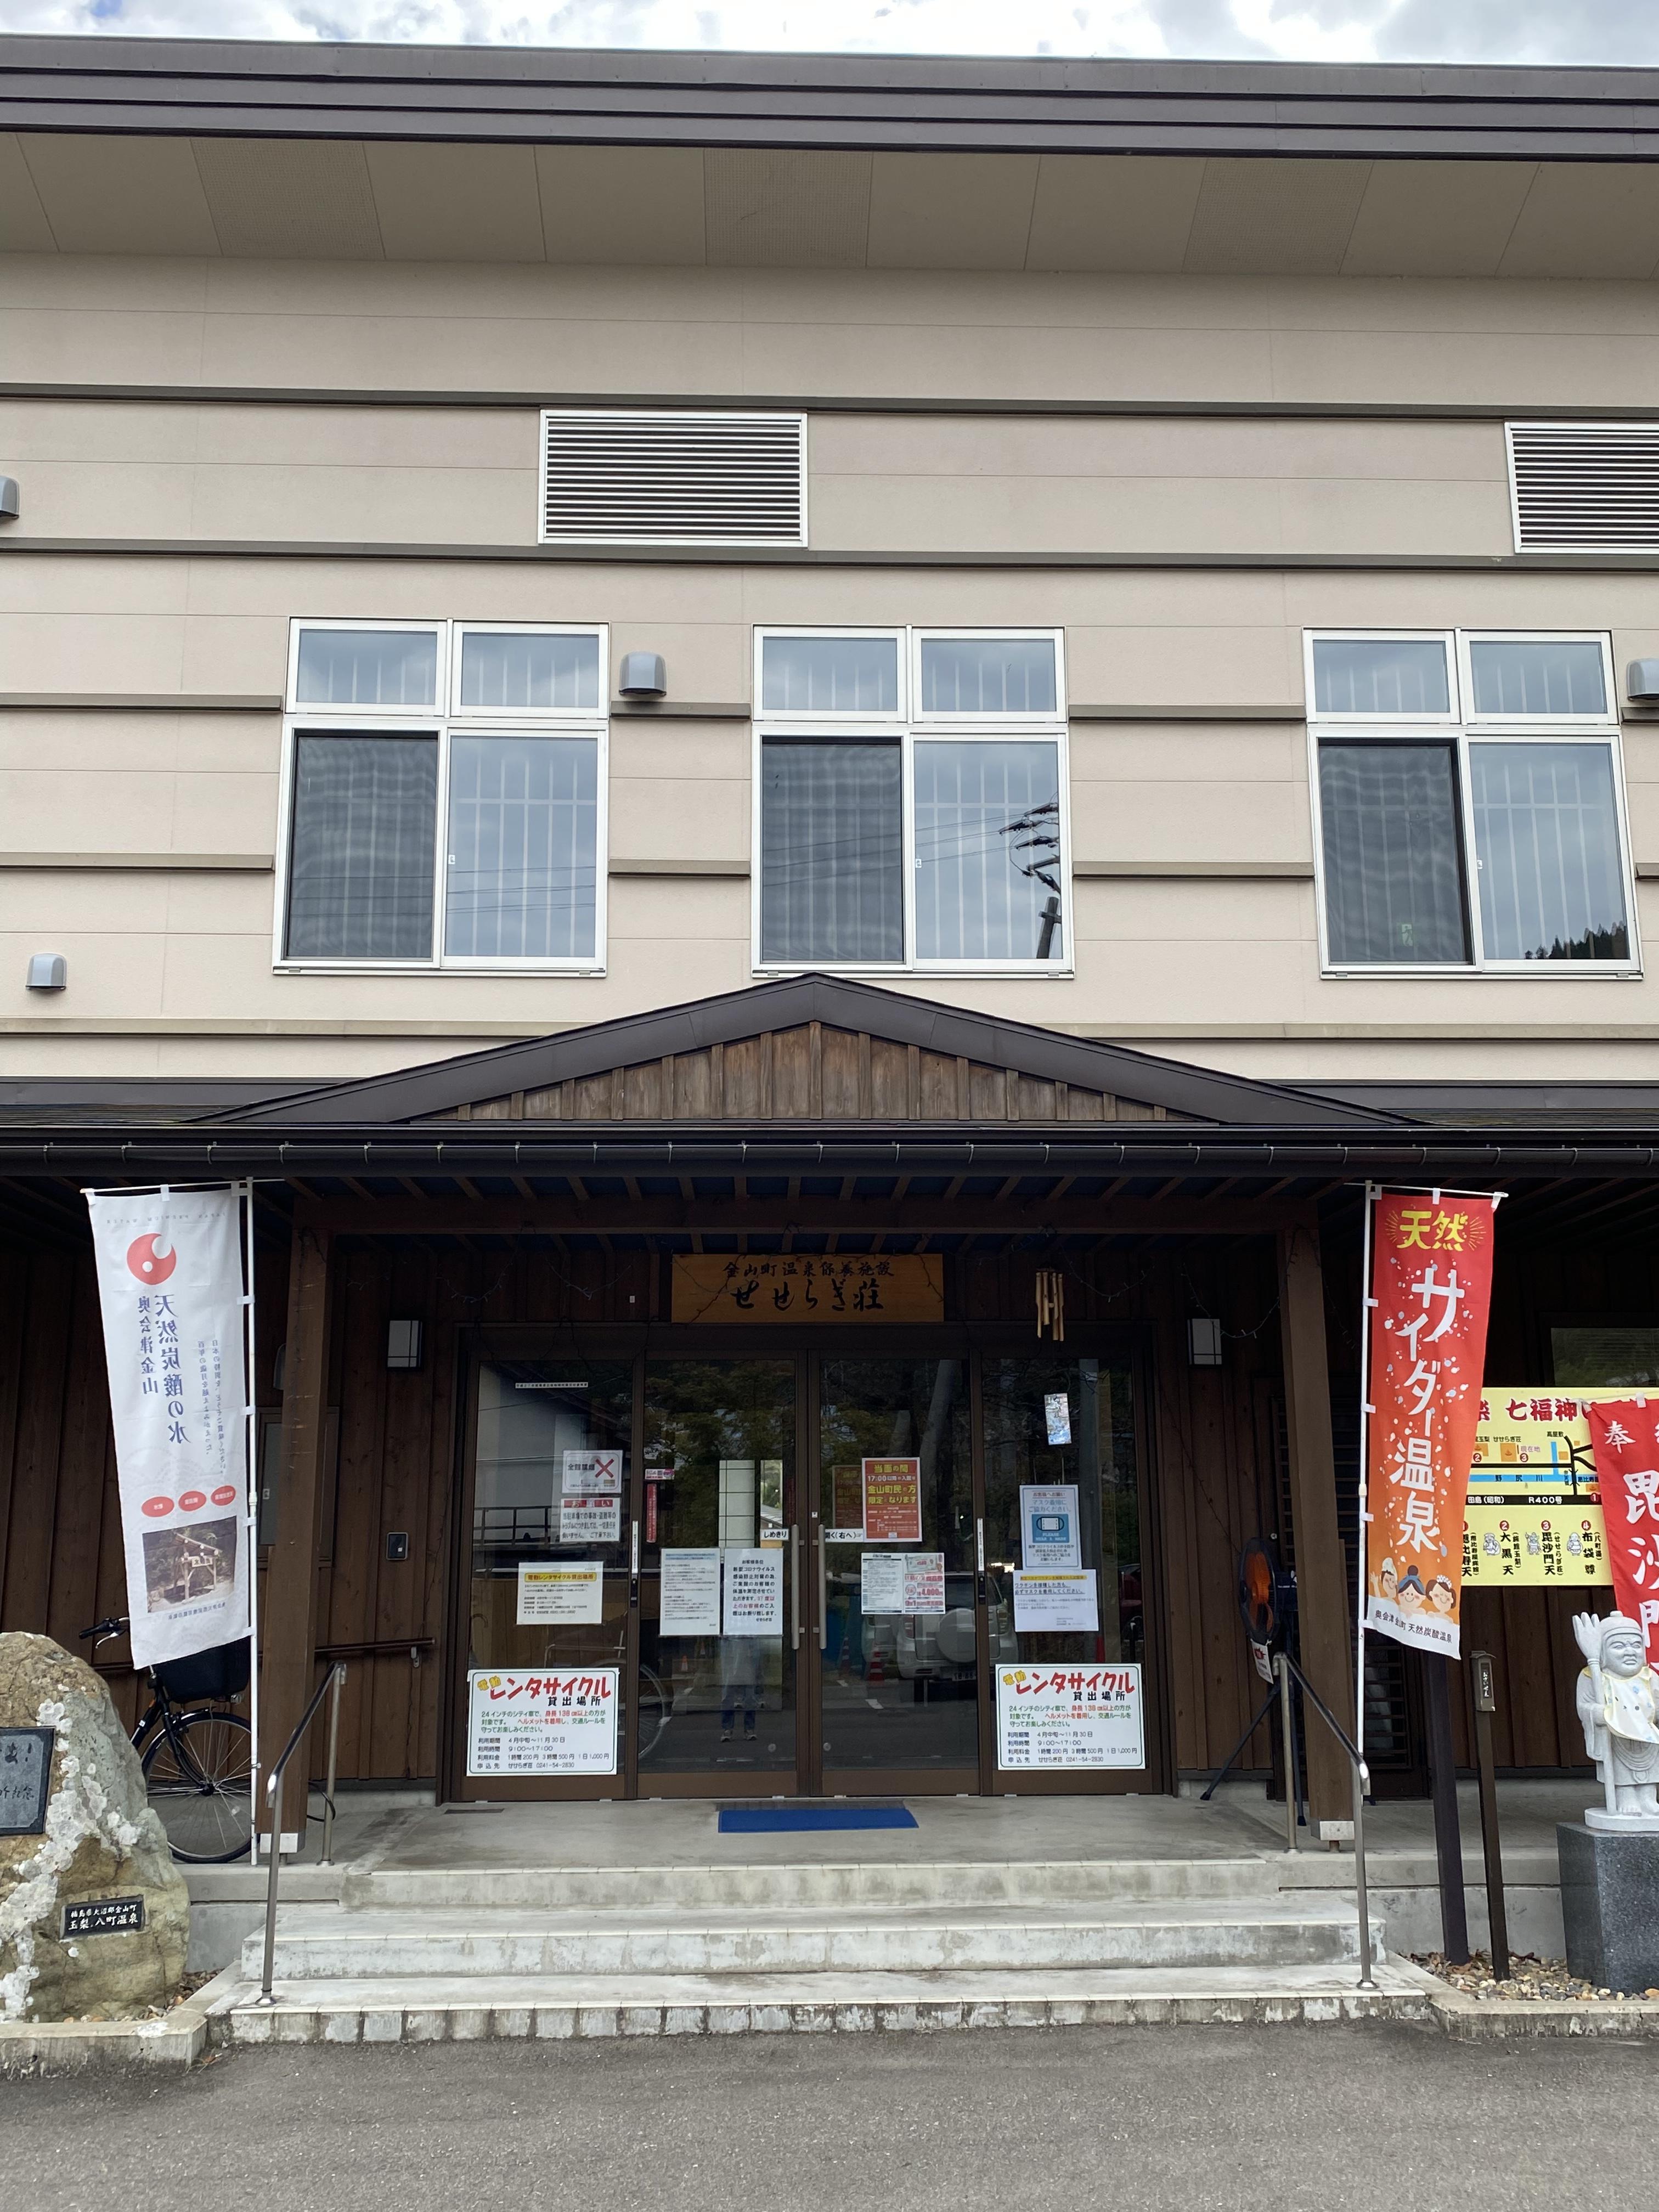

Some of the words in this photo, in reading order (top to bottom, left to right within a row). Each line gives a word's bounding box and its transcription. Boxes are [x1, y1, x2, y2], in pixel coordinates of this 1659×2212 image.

[1396, 1210, 1469, 1251] 天然
[722, 1261, 895, 1278] 金山町温泉保養施設
[731, 1278, 884, 1312] せせらぎ荘
[1389, 1266, 1466, 1555] サイダー温泉
[1505, 1398, 1588, 1421] 七福神
[874, 1465, 909, 1473] 当面の間
[1500, 1532, 1514, 1576] 大黒天
[1542, 1532, 1555, 1576] 毘沙門天
[1623, 1470, 1659, 1672] 毘沙門
[1375, 1610, 1406, 1630] 奥会津金町
[1408, 1623, 1452, 1643] 天然炭酸温泉
[490, 1677, 611, 1700] レンタサイクル
[1016, 1672, 1135, 1695] レンタサイクル
[548, 1696, 601, 1706] 貸出場所
[1073, 1691, 1125, 1701] 貸出場所
[71, 1905, 137, 1918] 福島県大沼郡金山町
